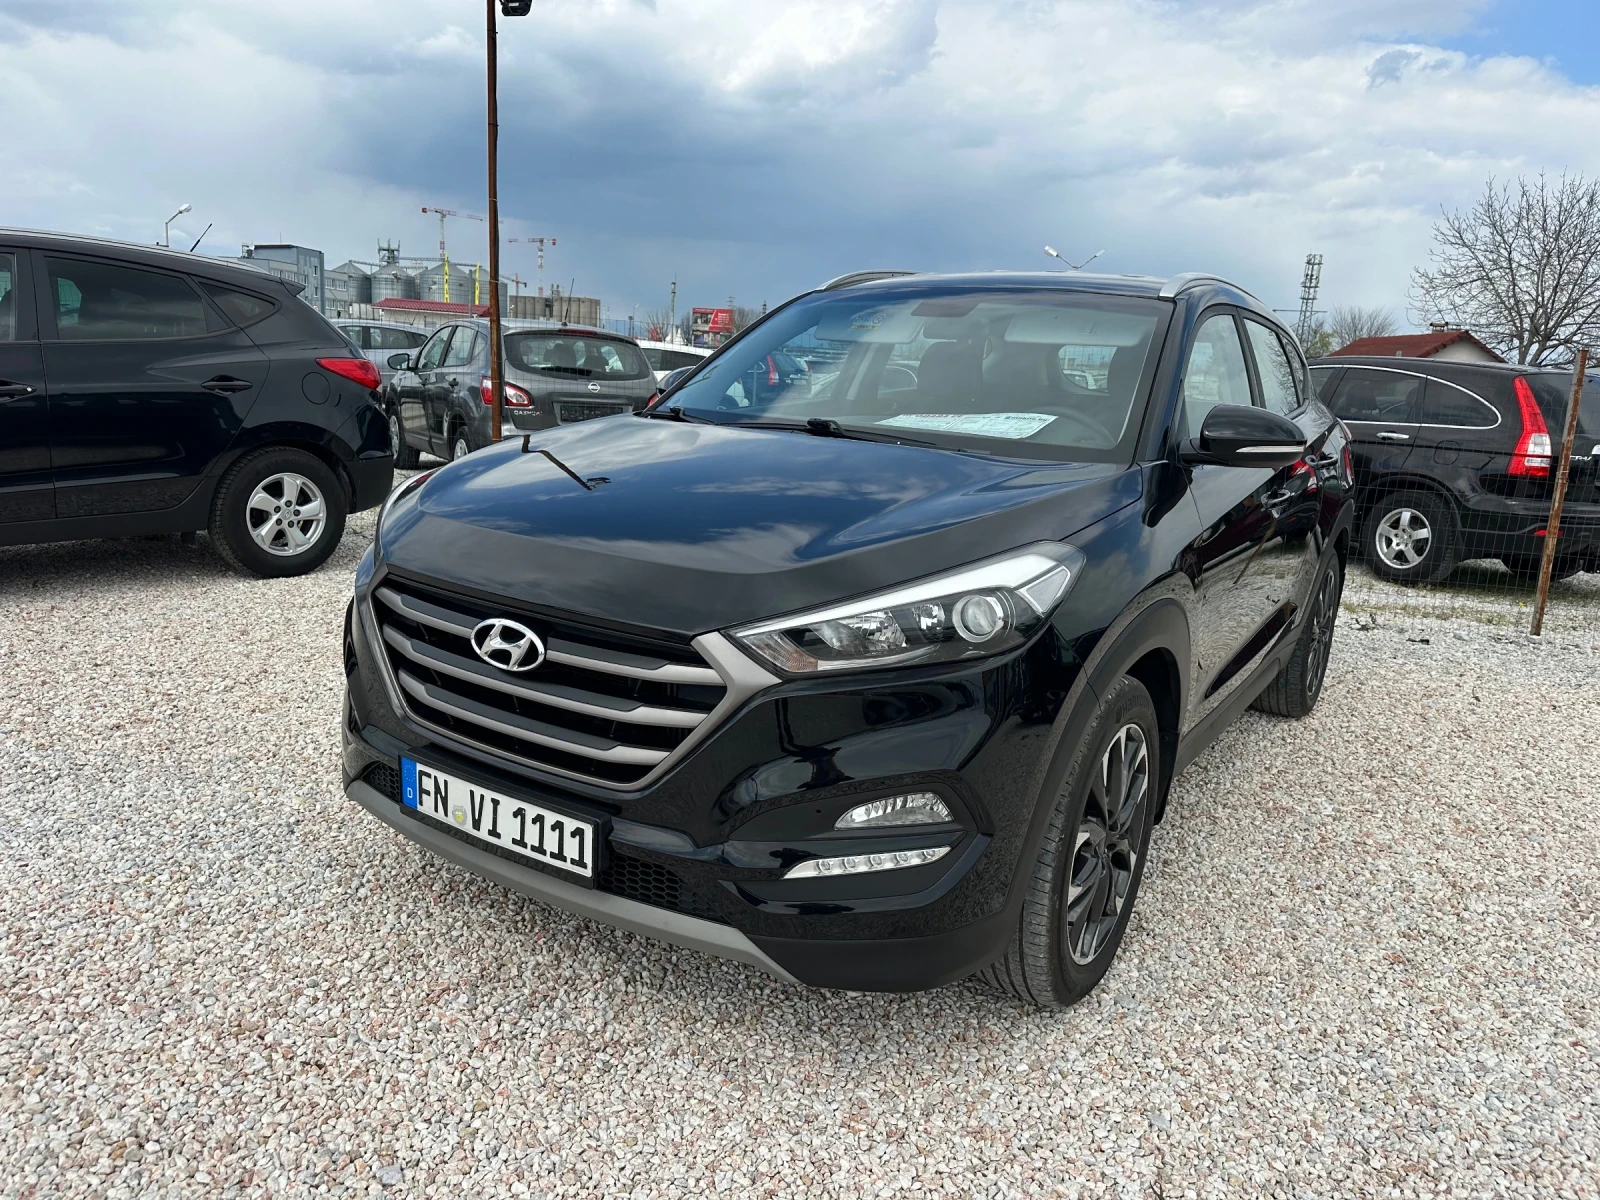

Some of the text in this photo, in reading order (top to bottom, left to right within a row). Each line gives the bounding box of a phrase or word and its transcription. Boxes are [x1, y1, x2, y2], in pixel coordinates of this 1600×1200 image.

[406, 787, 413, 798] D
[418, 769, 448, 818] FN
[469, 789, 501, 839] VI
[511, 806, 588, 870] 1111
